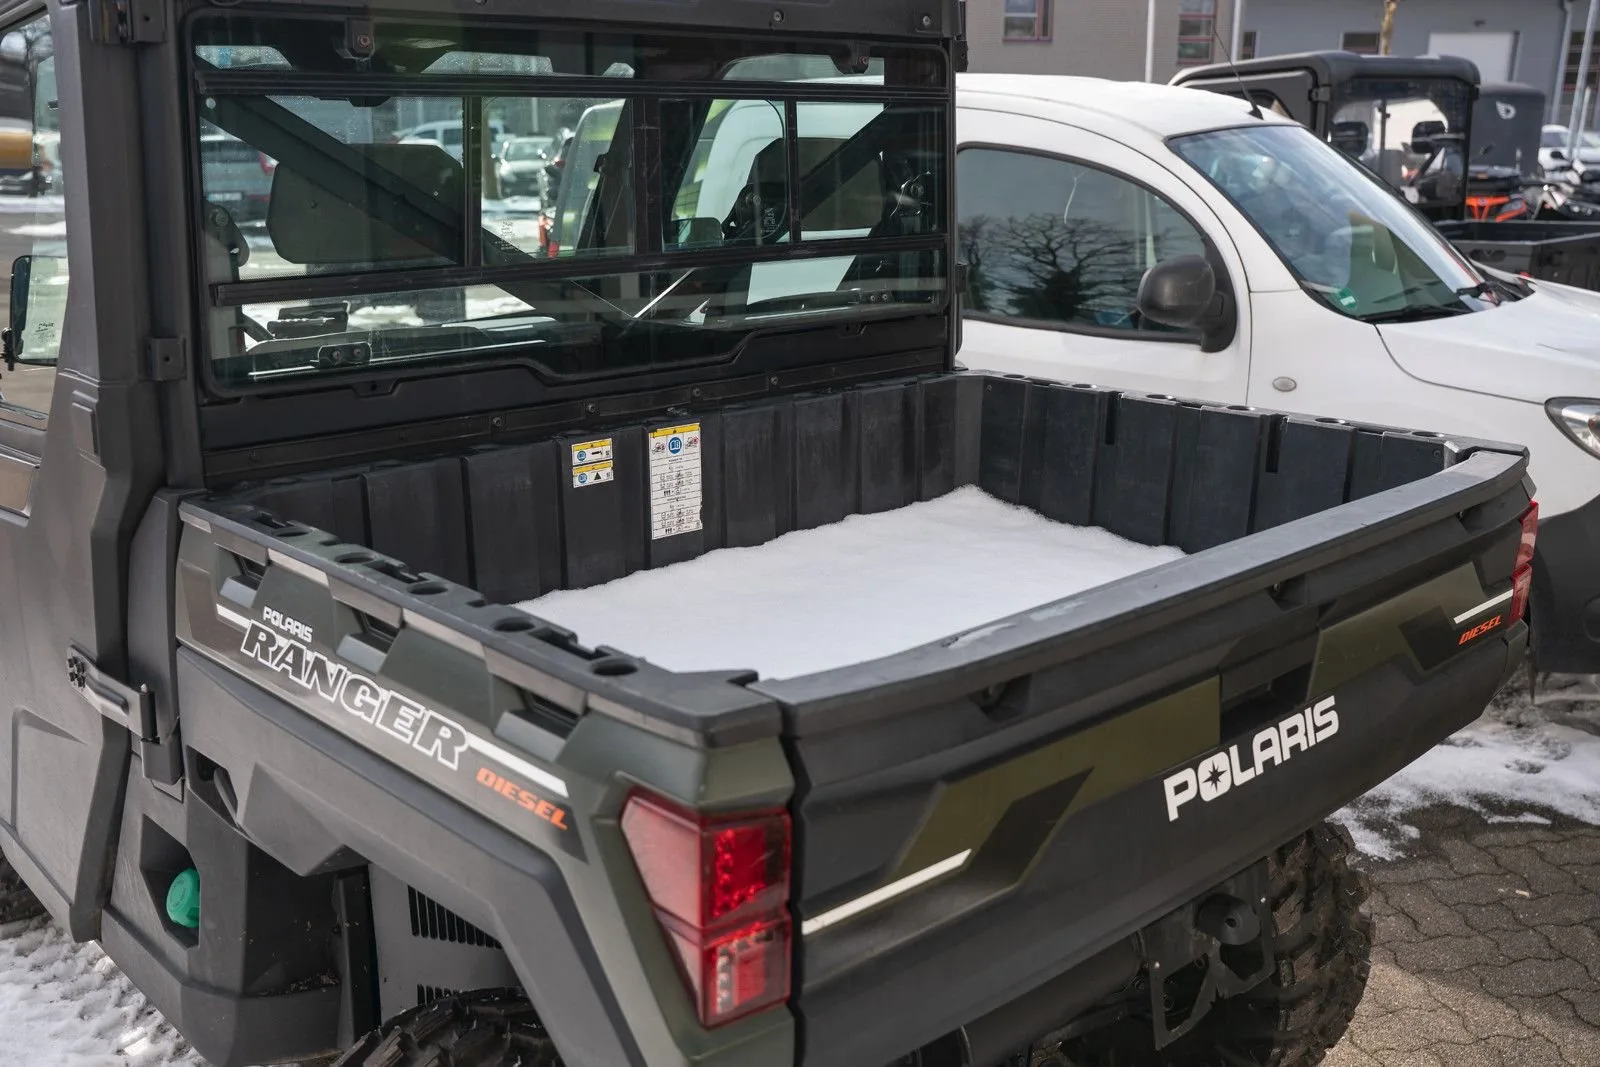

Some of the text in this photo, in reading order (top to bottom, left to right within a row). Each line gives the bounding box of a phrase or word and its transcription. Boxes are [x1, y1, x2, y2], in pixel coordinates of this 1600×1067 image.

[263, 606, 313, 643] POLARIS
[1458, 614, 1501, 645] DIESEL
[240, 619, 468, 771] RANGER
[1163, 695, 1339, 822] POLARIS
[476, 767, 568, 831] DIESEL
